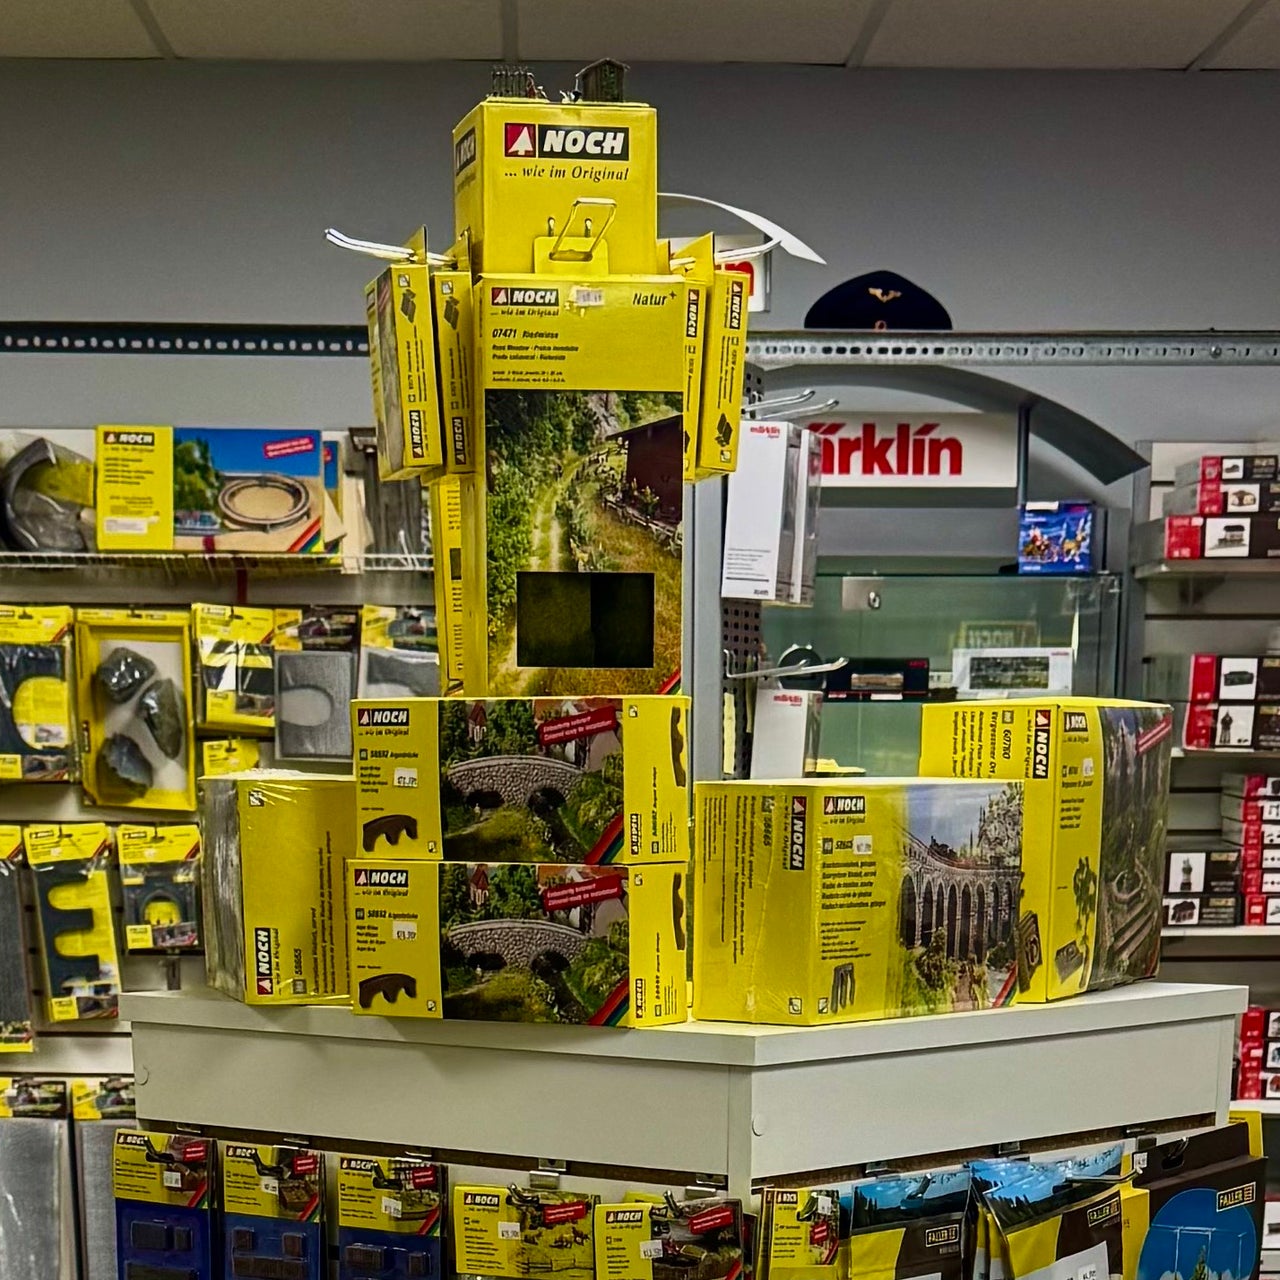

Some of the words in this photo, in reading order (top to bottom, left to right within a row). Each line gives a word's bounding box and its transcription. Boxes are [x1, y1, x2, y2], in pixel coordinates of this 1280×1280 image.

[543, 130, 624, 154] NOCH
[522, 167, 545, 177] wie
[550, 167, 565, 178] im
[571, 166, 629, 183] Original
[513, 290, 557, 303] NOCH
[492, 329, 517, 339] 07471
[810, 423, 962, 475] ärklin
[373, 711, 407, 724] NOCH
[1068, 713, 1086, 731] NOCH
[1036, 730, 1047, 777] NOCH
[836, 798, 864, 813] NOCH
[792, 822, 804, 869] NOCH
[371, 871, 407, 885] NOCH
[257, 930, 268, 974] NOCH
[1219, 1192, 1242, 1207] FALLER
[617, 1212, 642, 1223] NOCH
